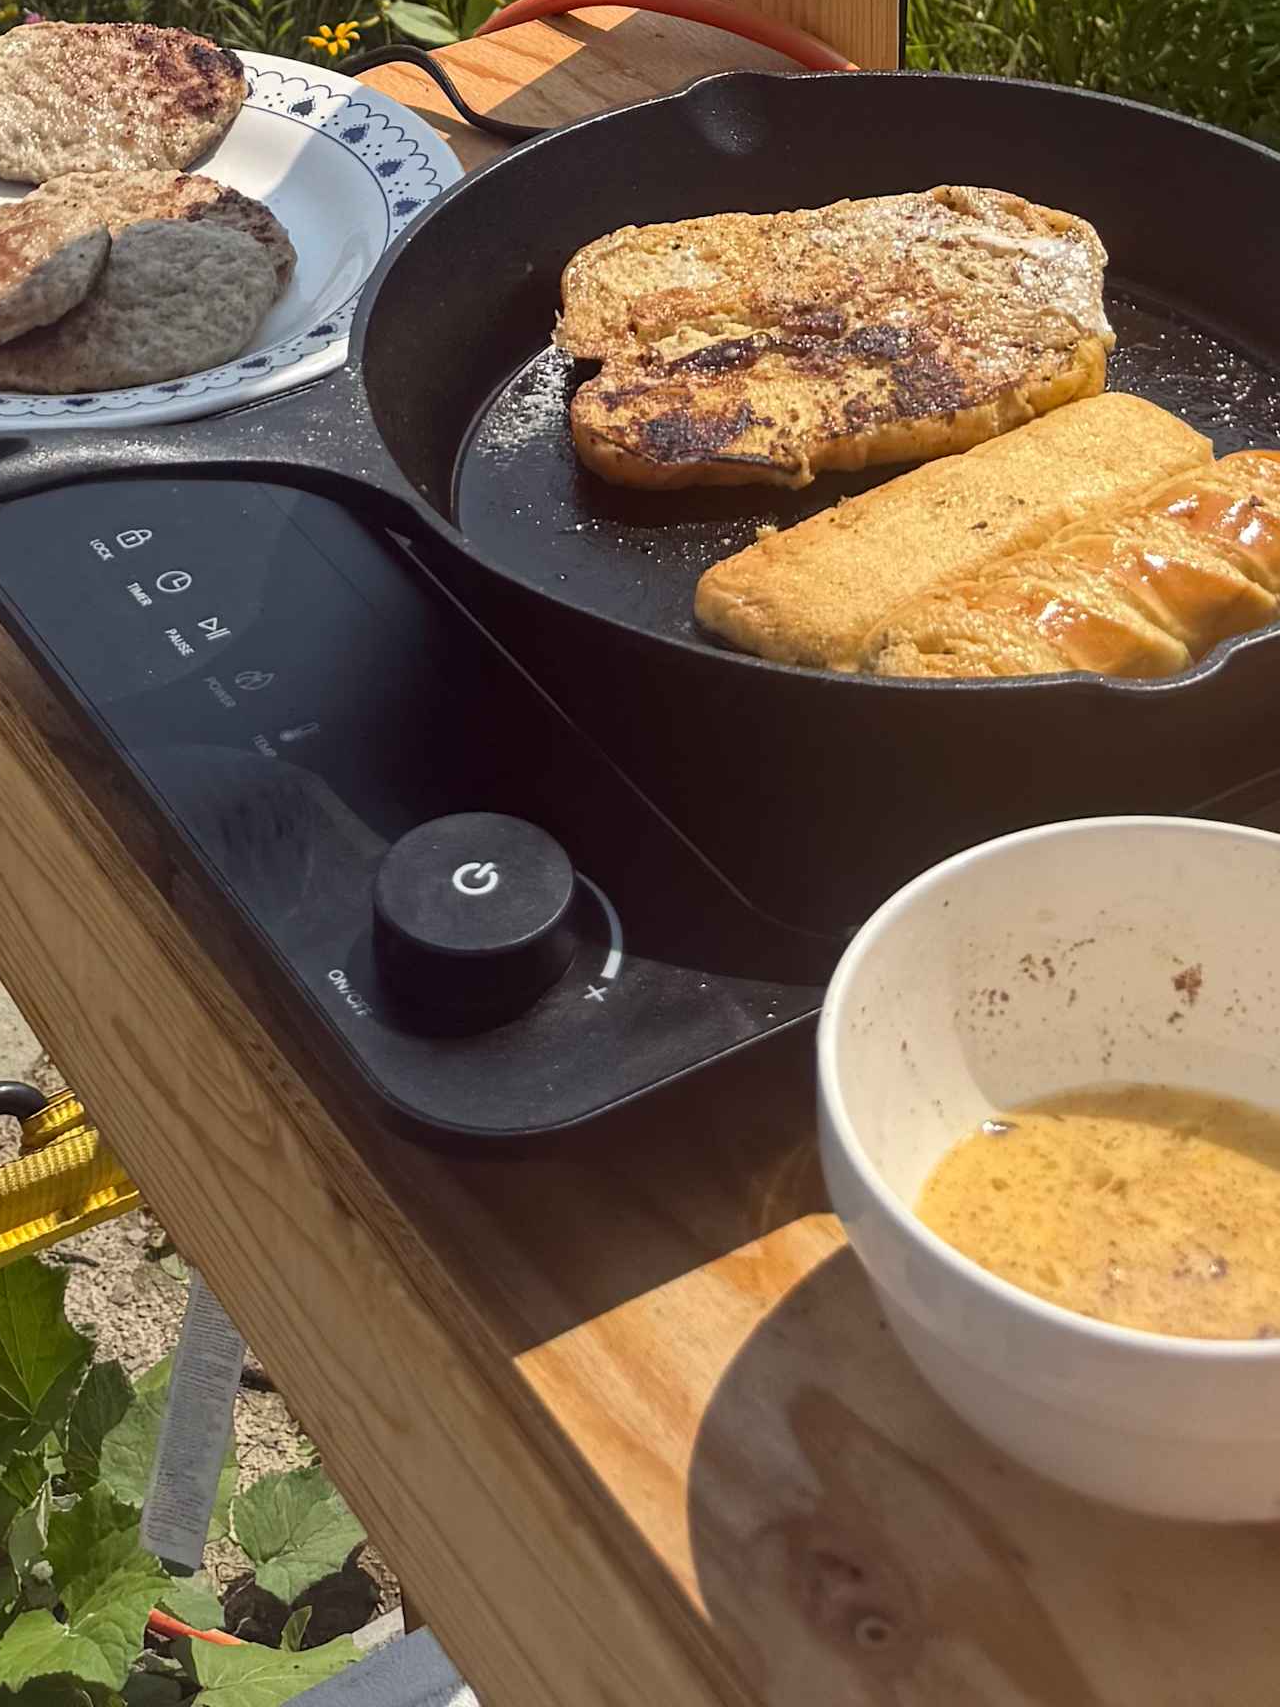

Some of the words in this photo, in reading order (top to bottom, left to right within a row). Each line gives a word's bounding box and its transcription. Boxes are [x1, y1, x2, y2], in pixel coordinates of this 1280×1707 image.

[90, 539, 114, 561] LOCK
[127, 582, 153, 606] TIMER
[164, 628, 195, 656] PAUSE
[201, 676, 236, 707] POWER
[252, 734, 277, 757] TEMP
[328, 969, 374, 1016] ON/OFF
